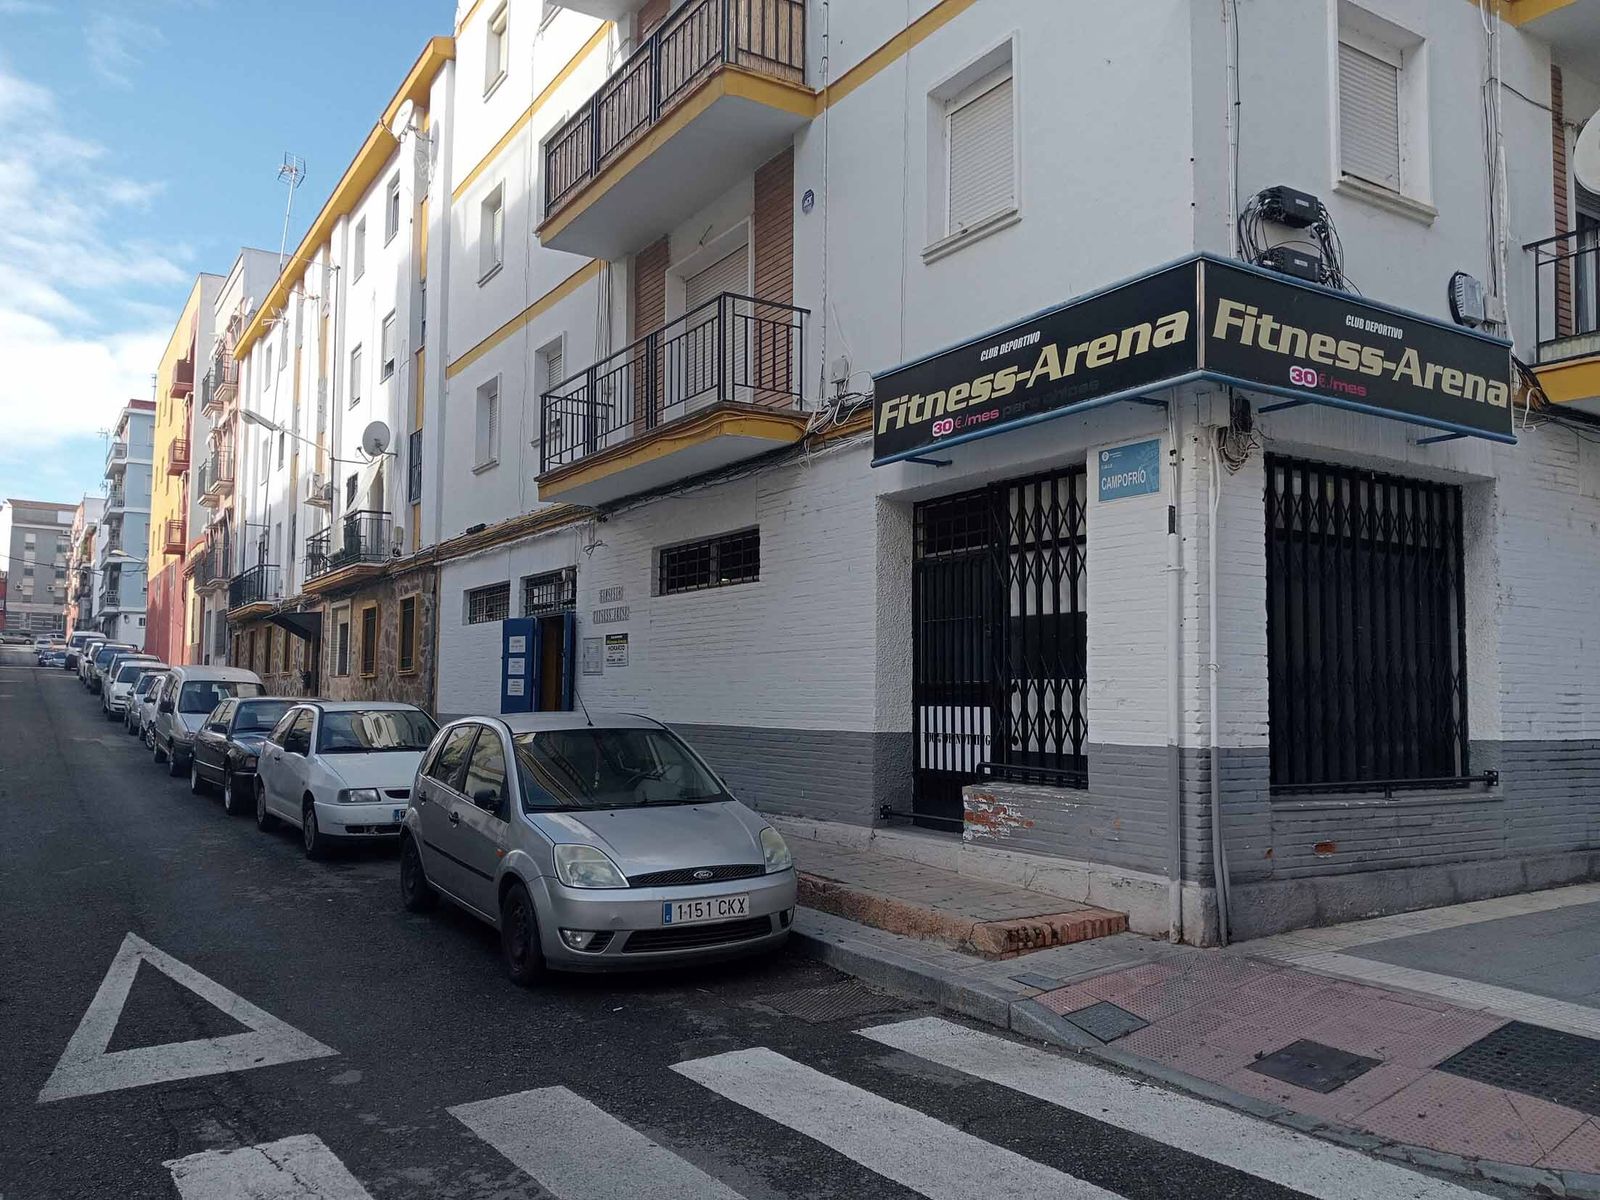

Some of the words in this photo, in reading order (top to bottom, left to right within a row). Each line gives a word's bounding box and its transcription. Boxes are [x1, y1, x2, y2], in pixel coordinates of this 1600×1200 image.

[1345, 314, 1364, 330] CLUB
[1365, 319, 1403, 340] DEPORTIVO
[981, 346, 999, 362] CLUB
[999, 331, 1041, 355] DEPORTIVO
[1212, 298, 1509, 409] Fitness-Arena
[877, 310, 1190, 435] Fitness-Arena
[1101, 466, 1146, 490] CAMPOFRÍO
[678, 901, 711, 920] 1151
[718, 897, 745, 916] CKX
